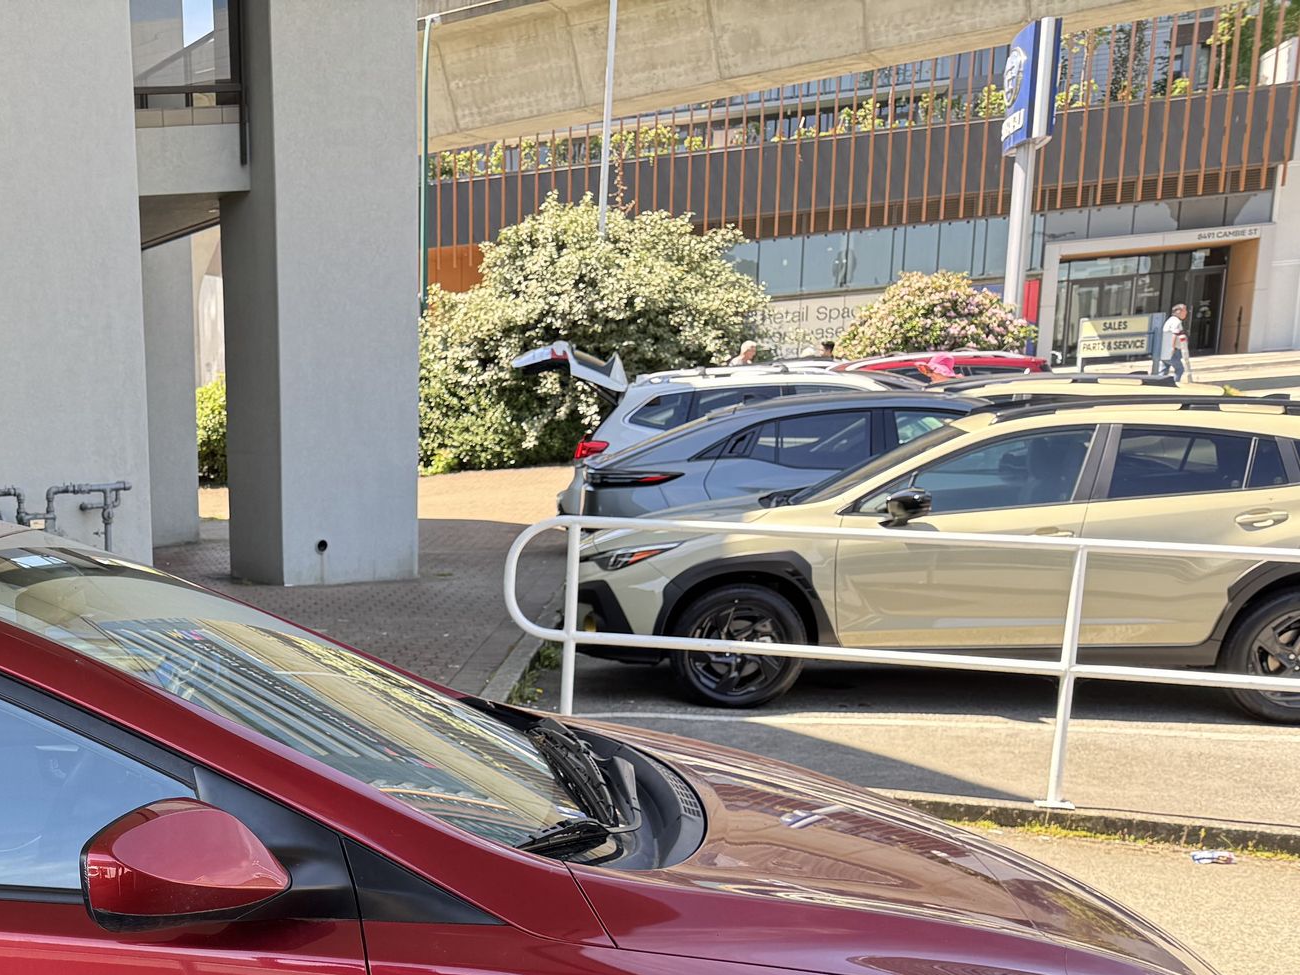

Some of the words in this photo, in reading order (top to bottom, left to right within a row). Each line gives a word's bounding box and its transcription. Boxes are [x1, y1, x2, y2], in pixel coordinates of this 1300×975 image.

[1102, 321, 1128, 331] SALES
[1083, 342, 1105, 351] PARTS
[1106, 342, 1112, 351] &
[1113, 339, 1145, 350] SERVICE
